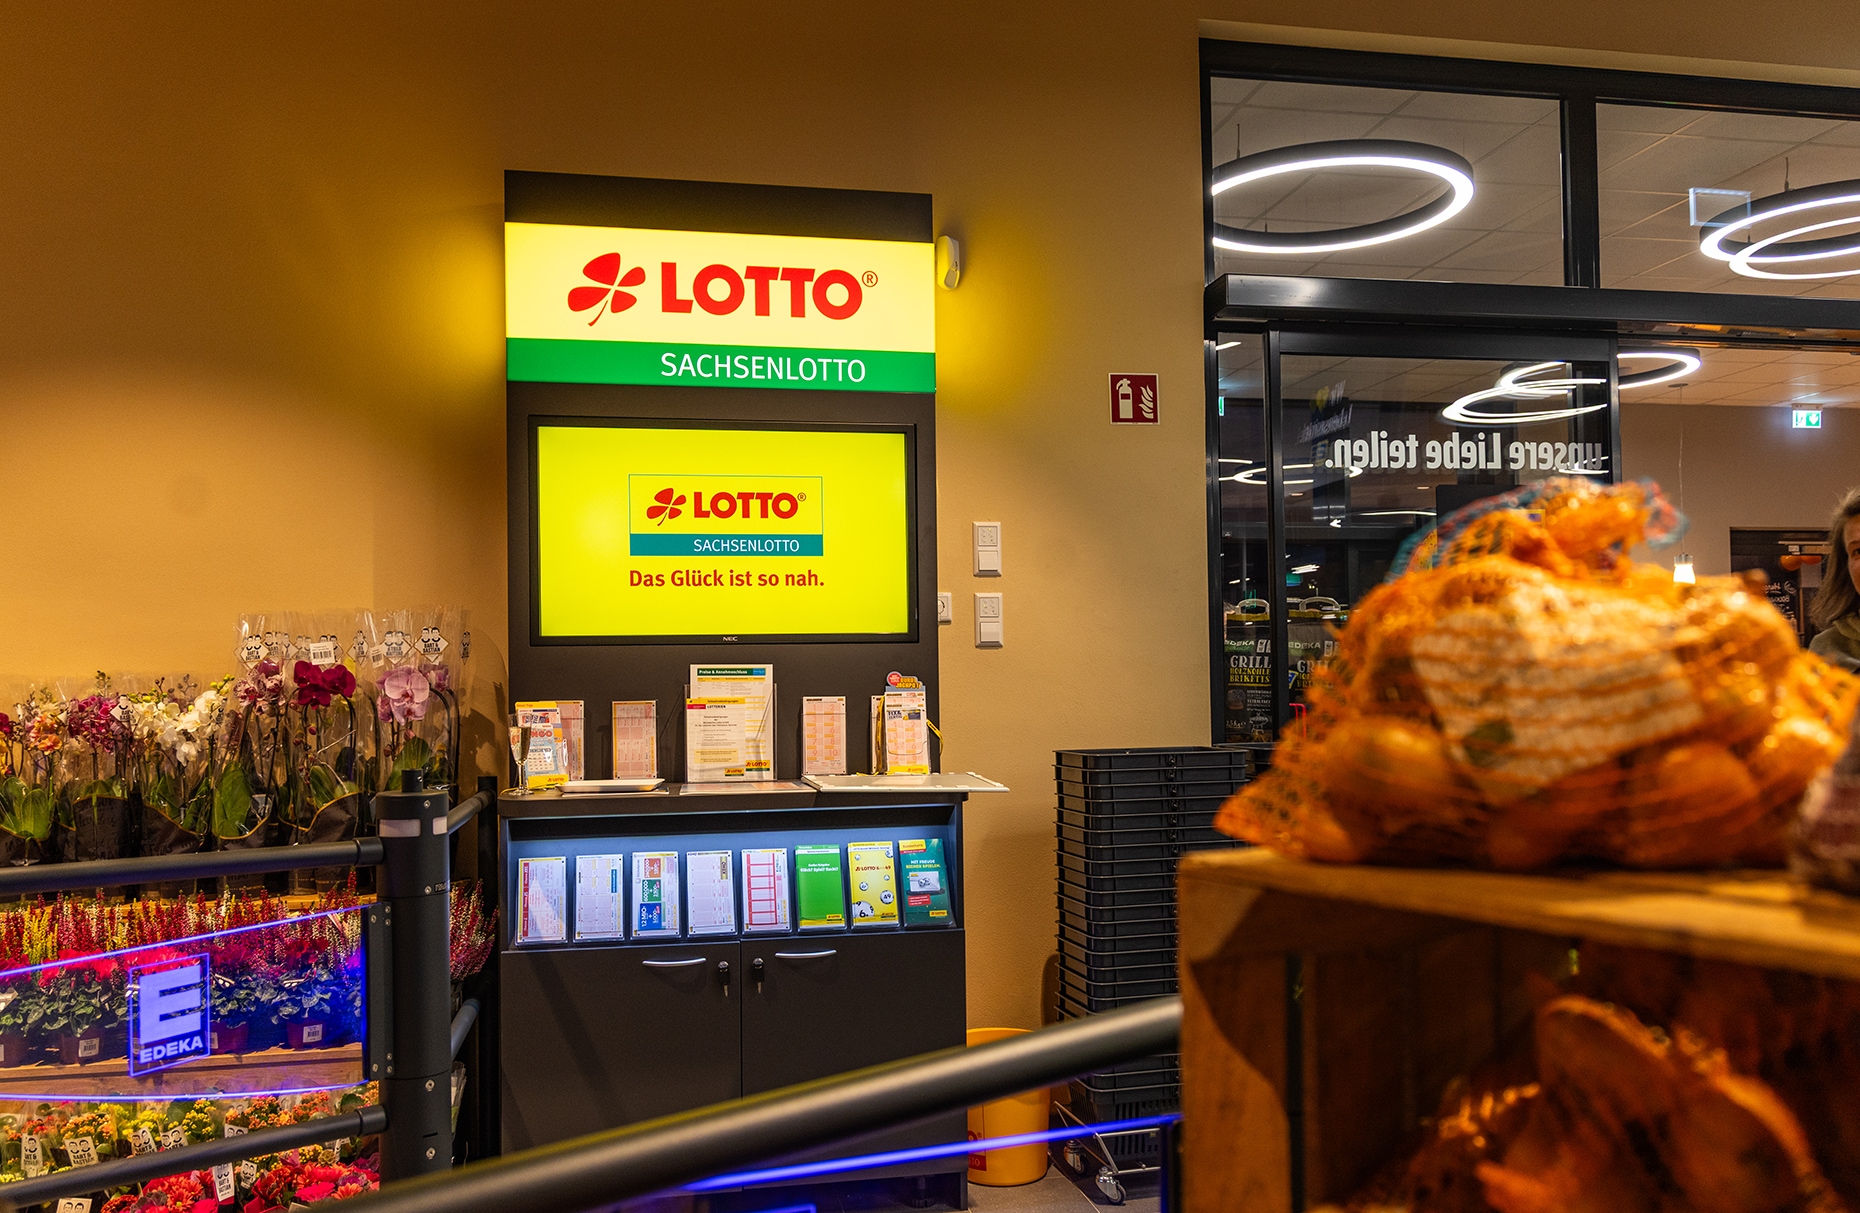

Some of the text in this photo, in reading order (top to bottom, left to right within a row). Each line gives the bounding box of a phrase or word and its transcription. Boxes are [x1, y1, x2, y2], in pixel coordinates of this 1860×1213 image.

[661, 353, 866, 383] SACHSENLOTTO
[693, 539, 800, 553] SACHSENLOTTO
[629, 568, 825, 587] Das Glück ist so nah.
[1230, 655, 1272, 668] GRILL
[1229, 667, 1271, 675] HOLZKOHLE
[1229, 674, 1271, 683] BRIKETTS
[139, 1036, 204, 1064] EDEKA
